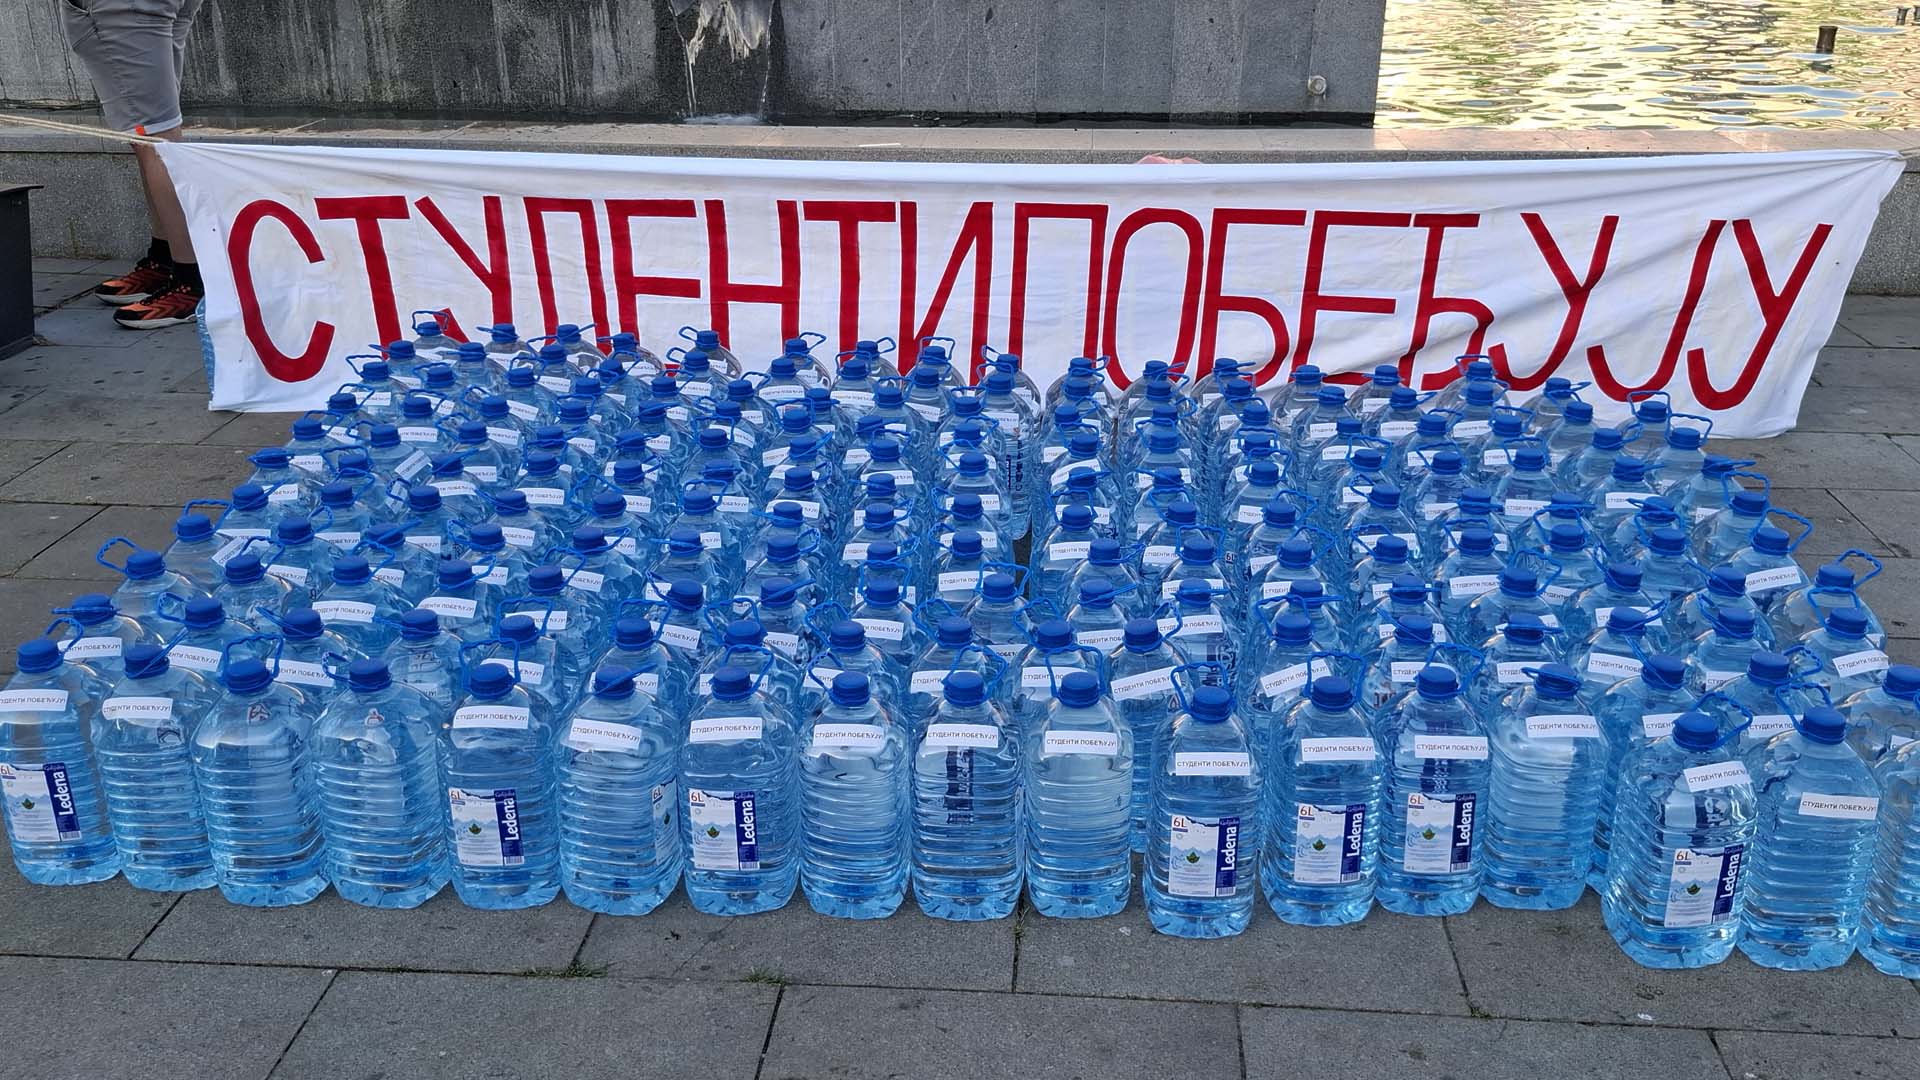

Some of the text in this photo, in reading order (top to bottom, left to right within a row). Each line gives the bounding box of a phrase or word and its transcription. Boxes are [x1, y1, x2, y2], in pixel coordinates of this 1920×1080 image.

[53, 771, 74, 816] Ledena
[691, 792, 704, 802] 6L
[1300, 805, 1313, 816] 6L
[1409, 794, 1424, 804] 6L
[502, 798, 519, 841] Ledena
[739, 800, 756, 845] Ledena
[1172, 817, 1186, 827] 6L
[1346, 812, 1363, 857] Ledena
[1455, 802, 1473, 847] Ledena
[1219, 826, 1236, 871] Ledena
[1676, 851, 1690, 862] 6L
[1720, 853, 1740, 898] Ledena
